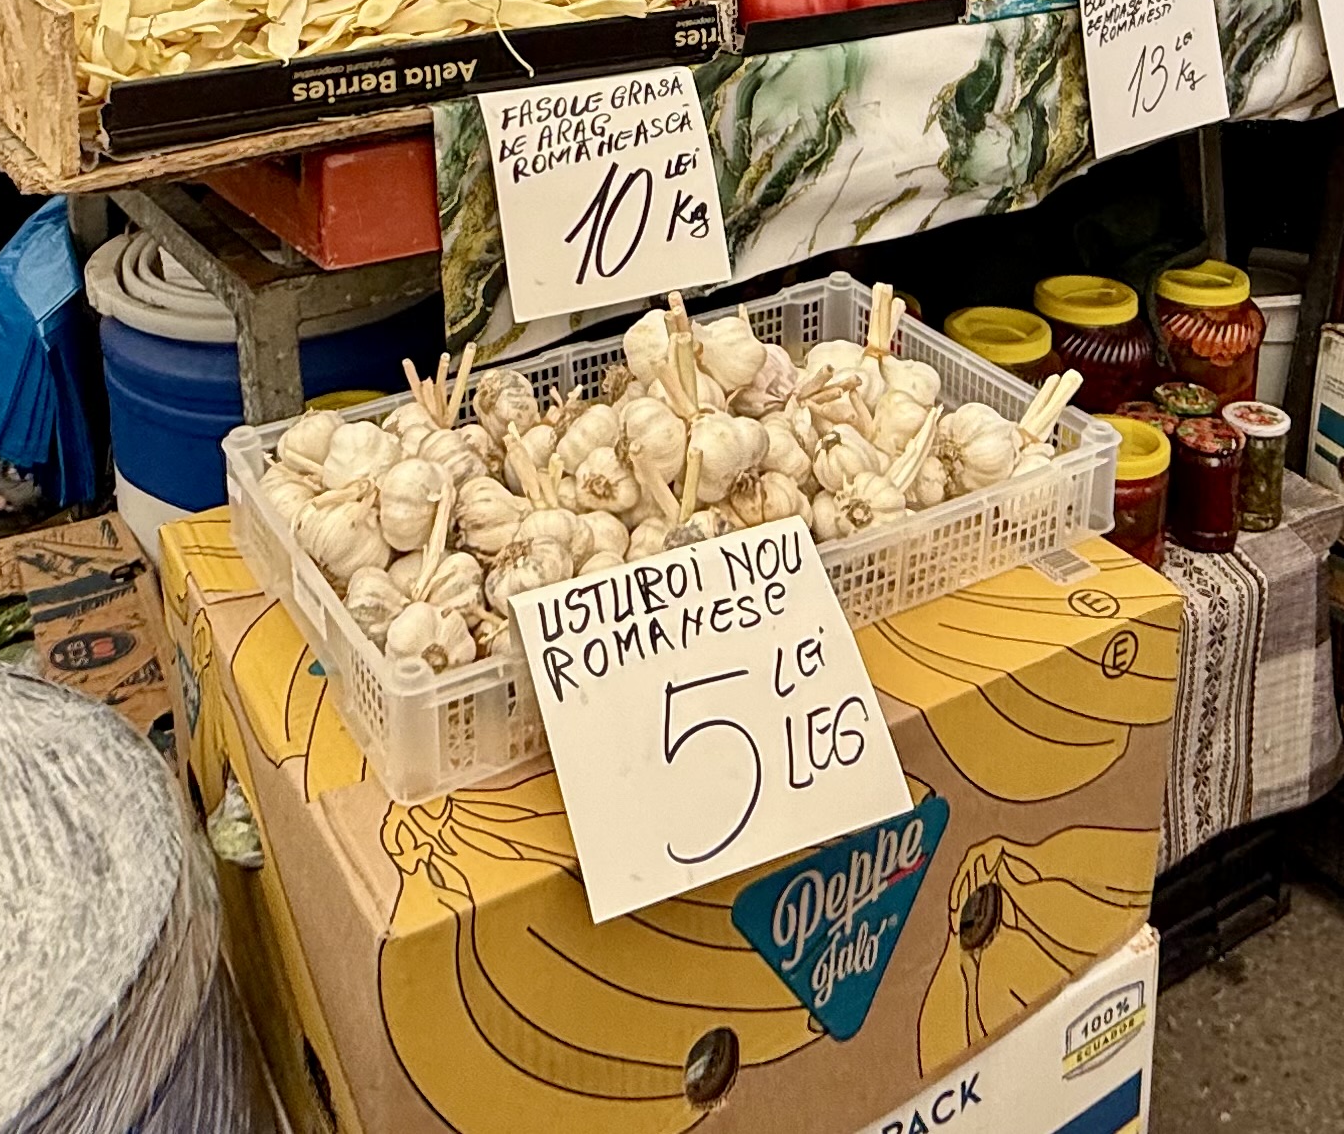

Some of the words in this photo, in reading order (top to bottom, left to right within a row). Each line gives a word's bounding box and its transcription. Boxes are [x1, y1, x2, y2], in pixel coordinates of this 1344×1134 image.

[293, 70, 397, 104] Berries
[404, 58, 478, 88] Aelia
[1128, 45, 1168, 118] 13
[501, 91, 603, 130] FASOLE
[564, 161, 654, 285] 10
[666, 189, 710, 242] Kg
[720, 531, 802, 592] NOU
[664, 669, 763, 866] 5
[785, 696, 870, 790] LEG
[772, 818, 925, 972] Peppe
[1075, 1018, 1136, 1064] ECUADOR
[1080, 996, 1131, 1040] 100%
